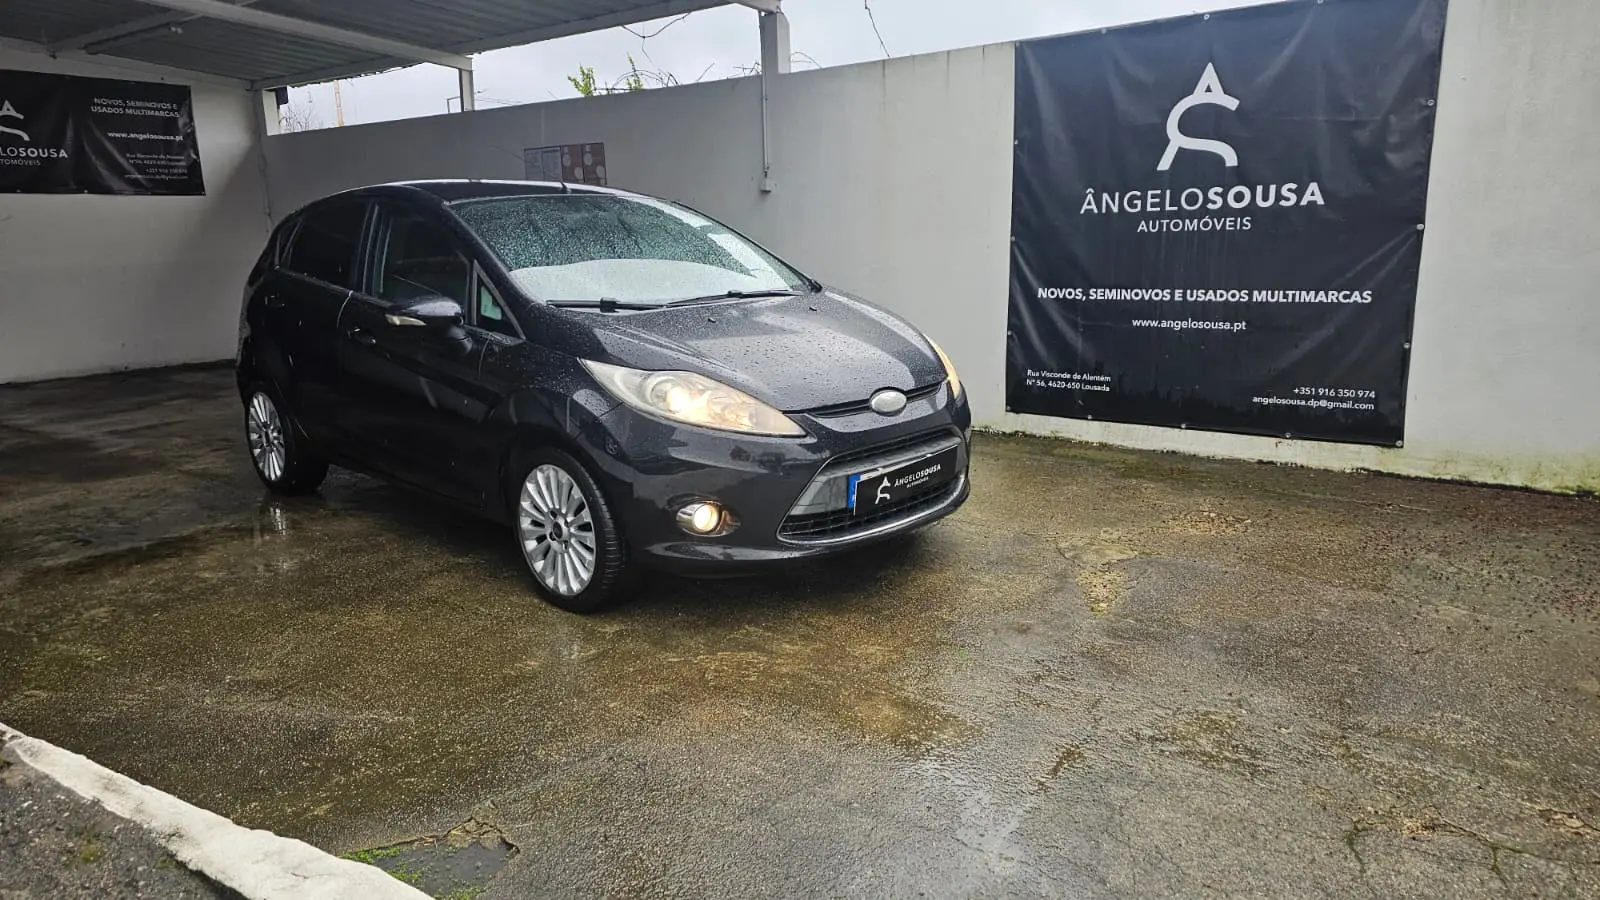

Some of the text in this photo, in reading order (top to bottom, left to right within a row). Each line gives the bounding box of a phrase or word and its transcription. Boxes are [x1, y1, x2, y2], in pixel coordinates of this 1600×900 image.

[90, 106, 180, 118] USADOS MULTIMARCAS
[1137, 215, 1253, 233] AUTOMÓVEIS
[1037, 287, 1373, 304] NOVOS, SEMINOVOS E USADOS MULTIMARCAS
[1132, 317, 1247, 332] www.angelosousa.pt
[1027, 369, 1040, 377] Rua
[1040, 370, 1071, 379] Visconde
[1072, 372, 1081, 380] de
[1036, 379, 1047, 388] 56,
[1047, 380, 1080, 390] 4620-650
[1081, 383, 1110, 392] Lousada
[1293, 386, 1376, 399] +351 916 350 974
[1252, 395, 1375, 410] angelosousa.dp@gmail.com
